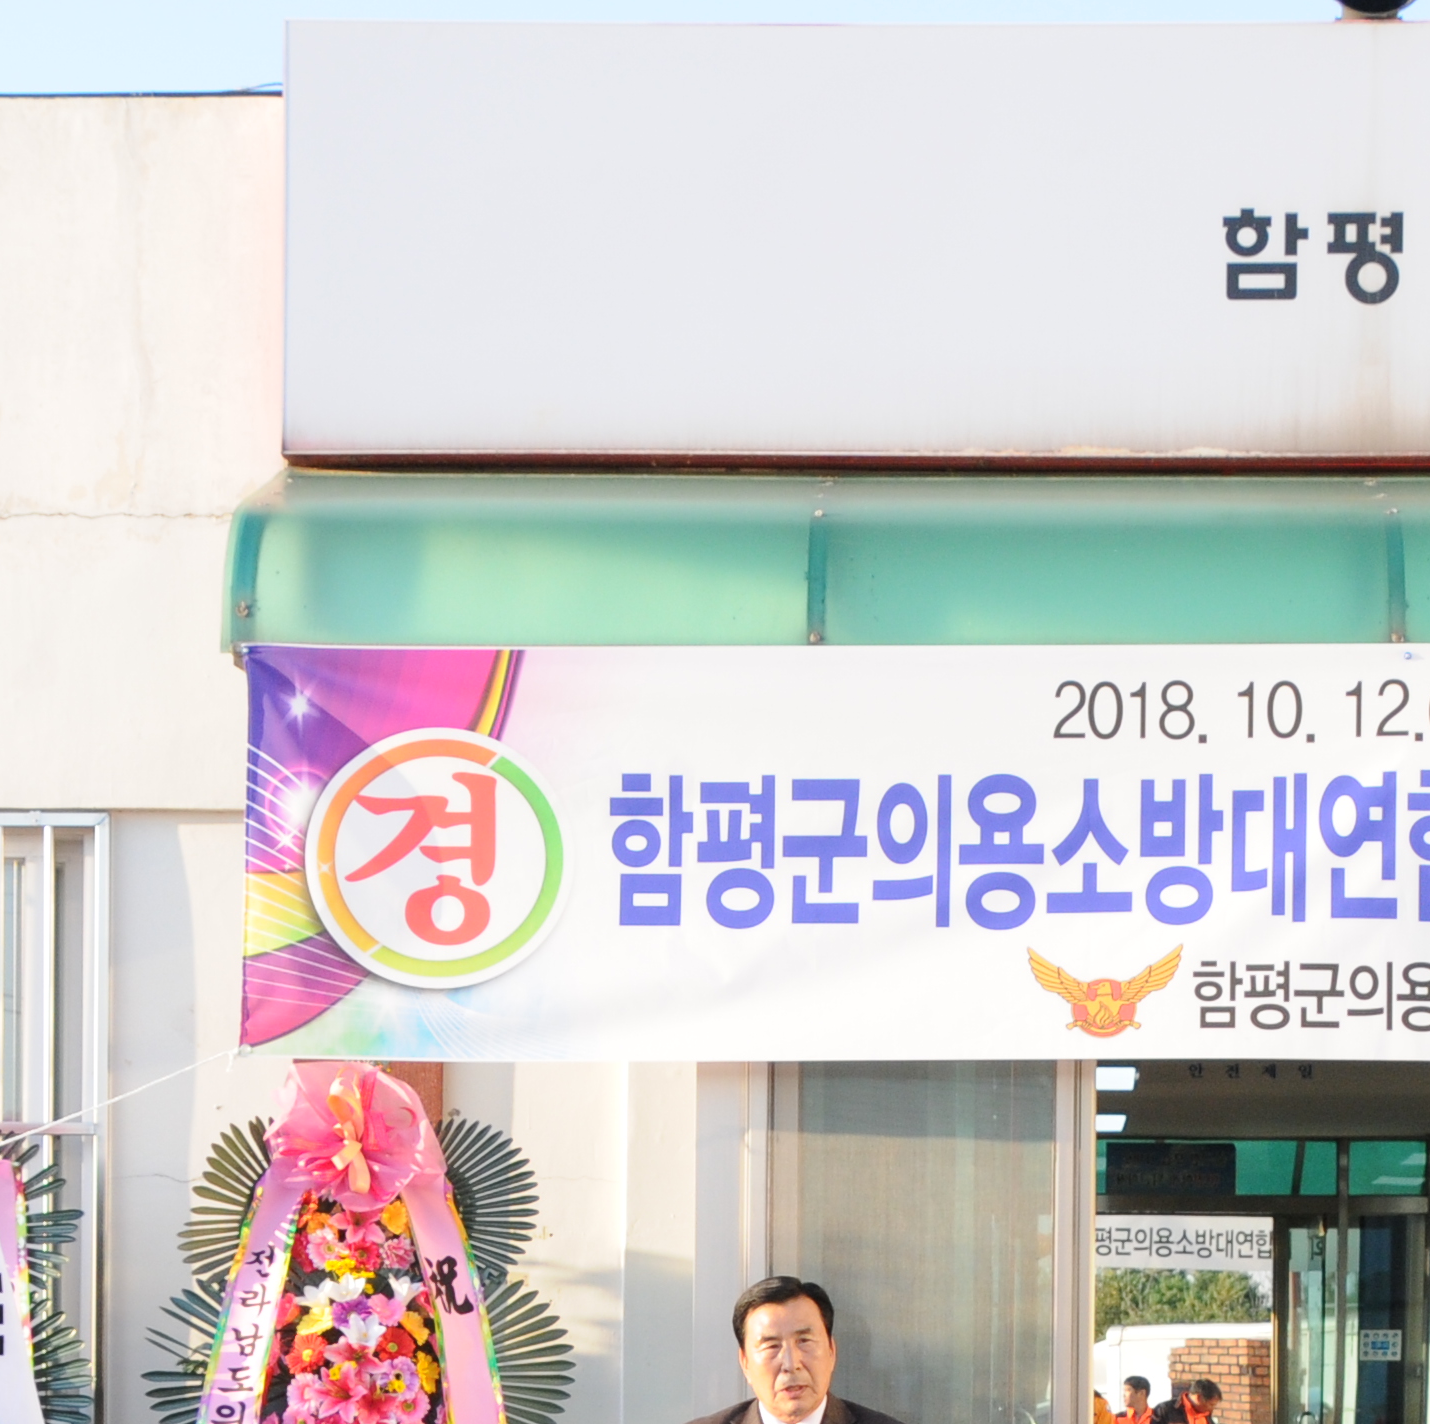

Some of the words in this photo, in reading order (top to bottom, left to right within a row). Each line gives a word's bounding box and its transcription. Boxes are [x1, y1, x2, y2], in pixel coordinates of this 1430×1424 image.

[1053, 679, 1208, 744] 2018.
[1237, 680, 1315, 743] 10.
[344, 771, 497, 947] 경
